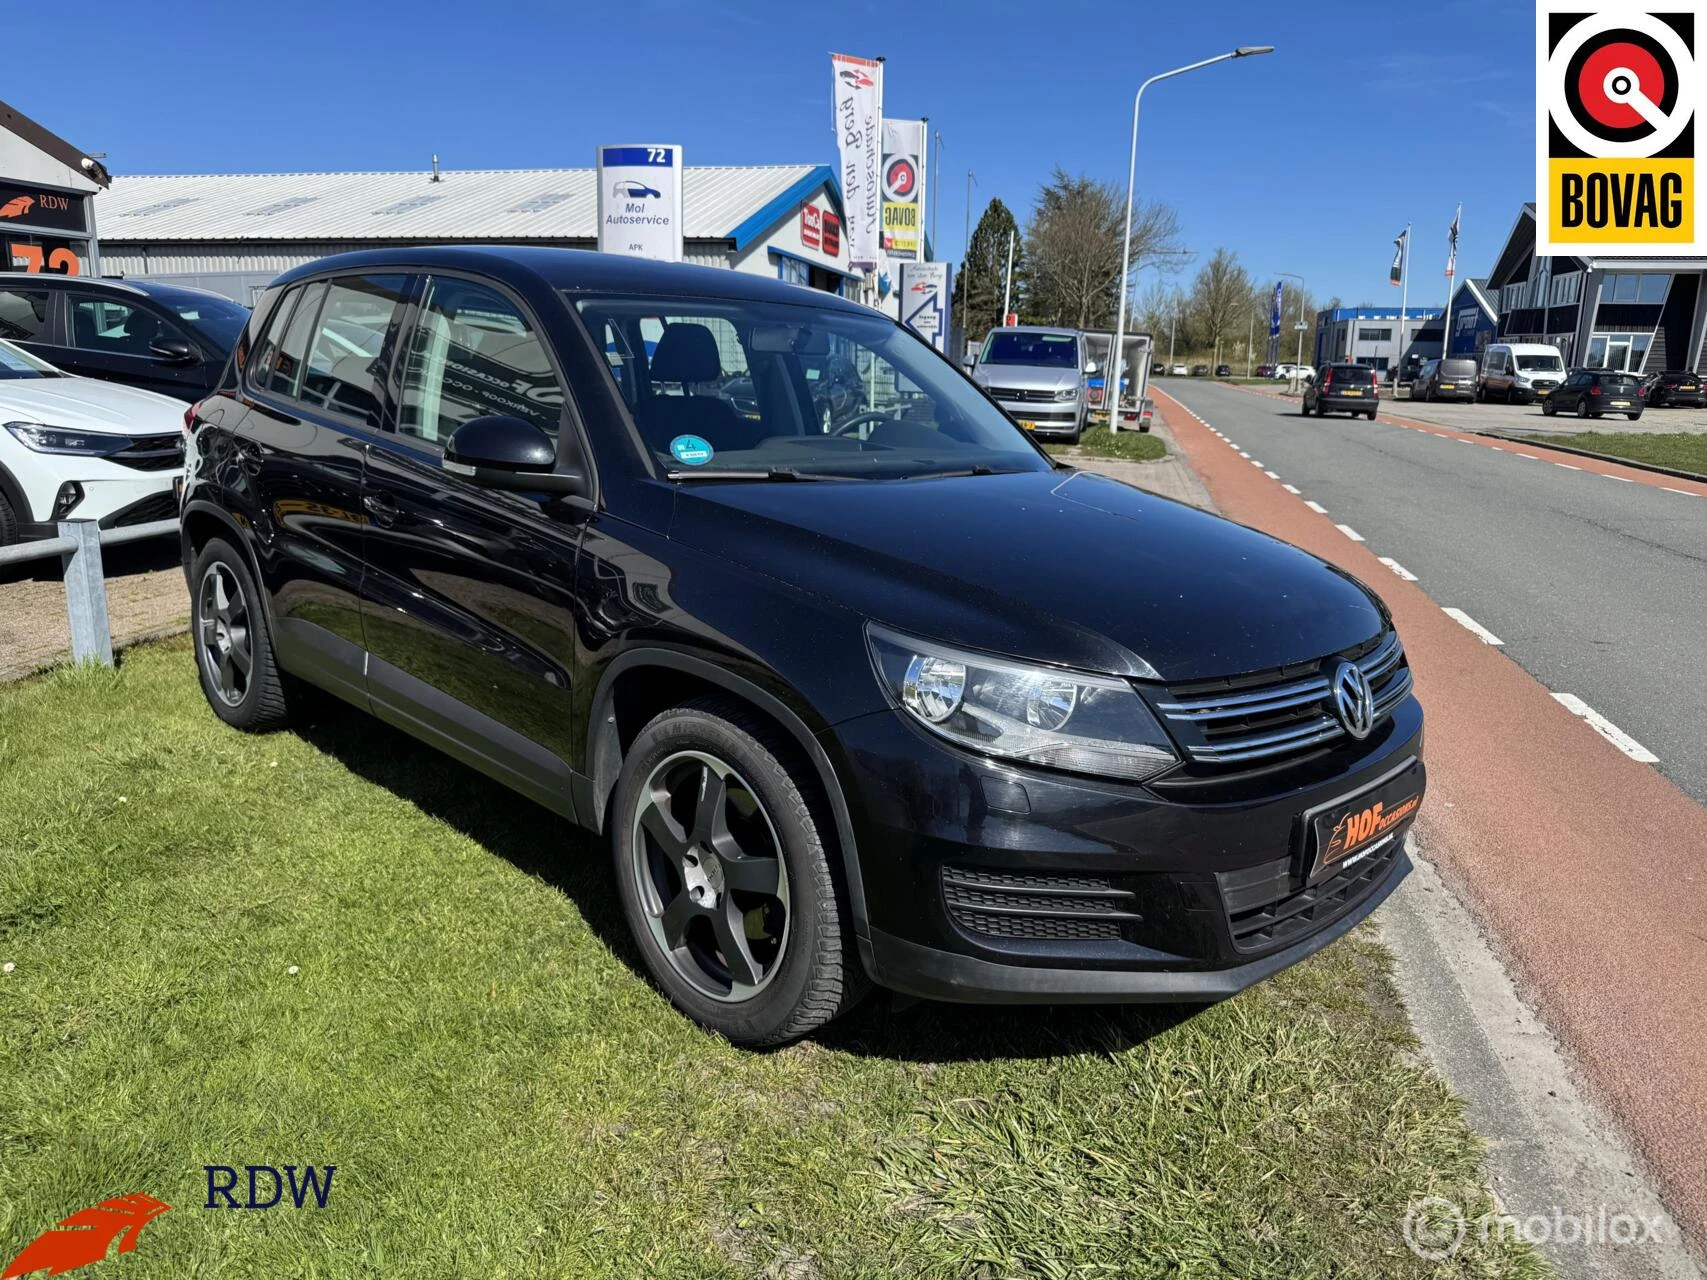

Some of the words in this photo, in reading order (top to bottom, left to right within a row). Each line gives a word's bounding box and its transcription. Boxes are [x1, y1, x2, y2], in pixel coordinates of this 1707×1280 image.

[647, 148, 666, 162] 72
[40, 195, 69, 210] RDW
[625, 203, 645, 213] Mol
[606, 215, 670, 226] Autoservice
[628, 243, 643, 251] APK
[1343, 801, 1384, 850] HOF
